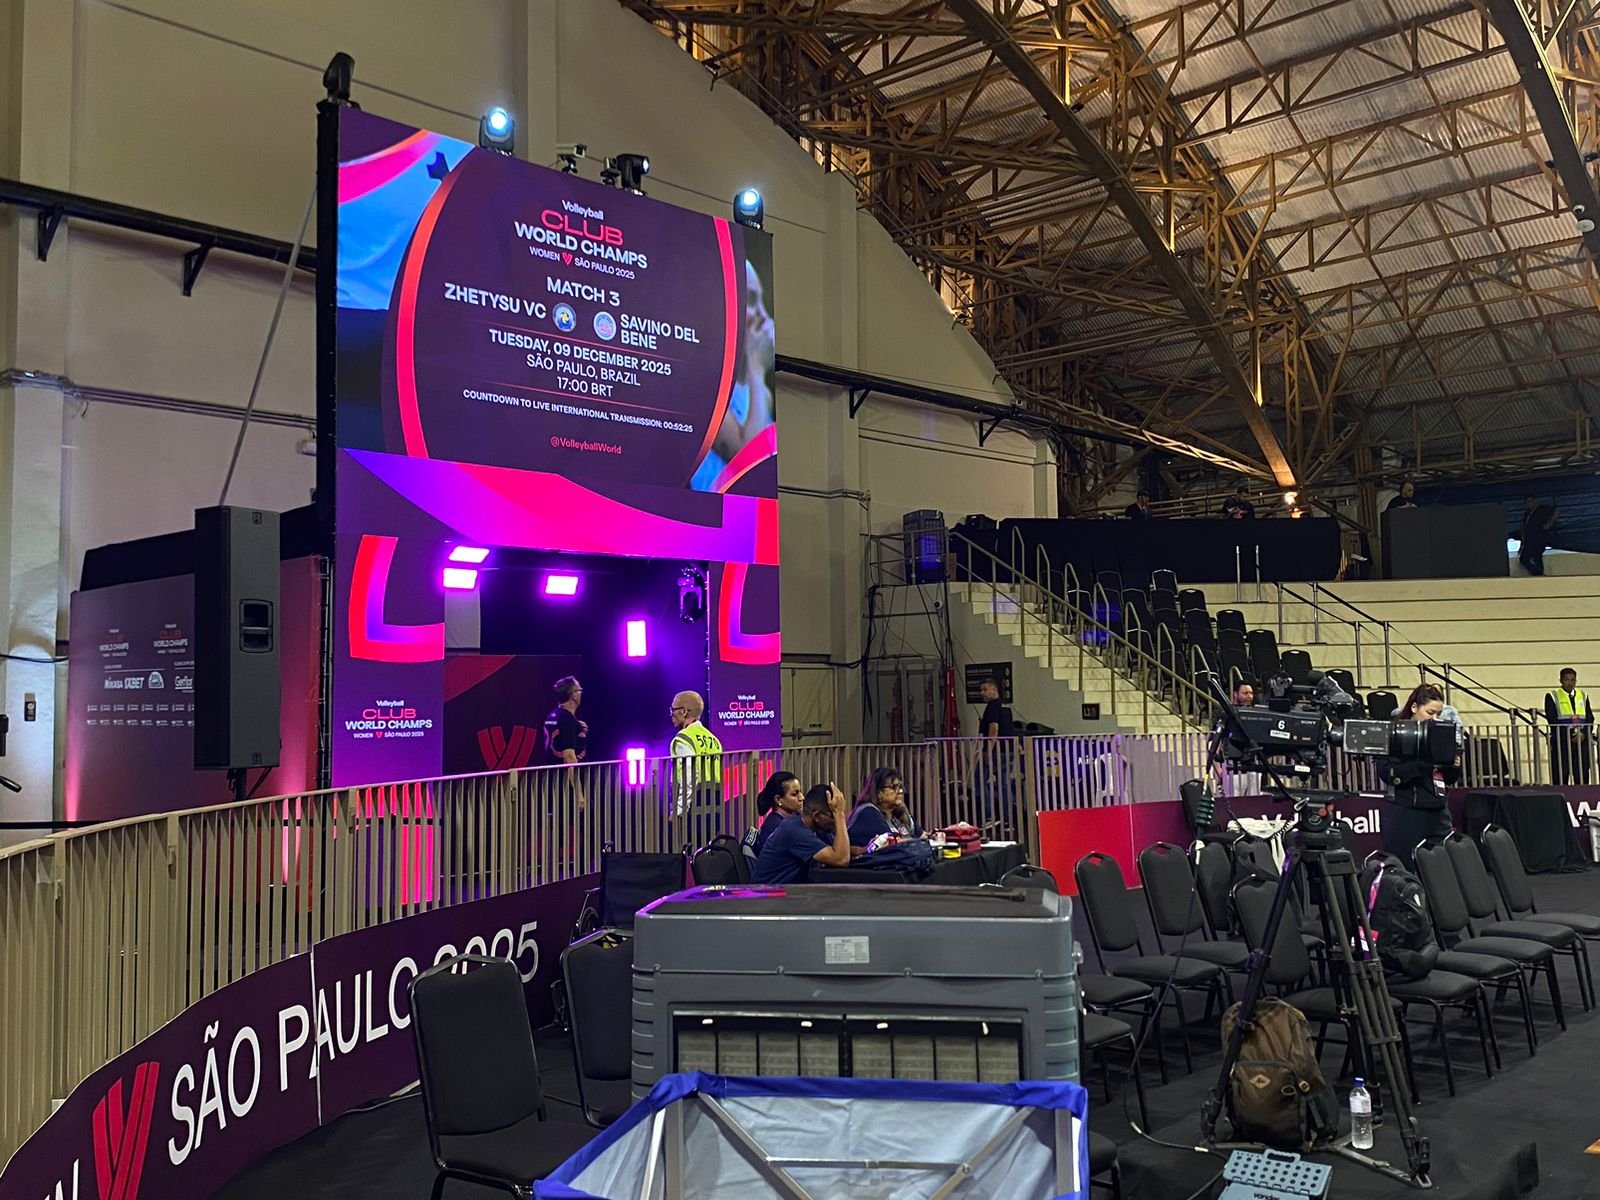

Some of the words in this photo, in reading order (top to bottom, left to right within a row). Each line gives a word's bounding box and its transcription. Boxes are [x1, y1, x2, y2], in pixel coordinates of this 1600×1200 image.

[562, 199, 604, 221] Volleyball
[541, 209, 623, 246] CLUB
[514, 221, 577, 251] WORLD
[581, 239, 648, 269] CHAMPS
[529, 246, 560, 262] WOMEN
[574, 256, 591, 269] SÃO
[591, 260, 615, 275] PAULO
[615, 266, 635, 280] 2025
[444, 282, 520, 314] ZHETYSU
[523, 299, 547, 319] VC
[547, 277, 605, 304] MATCH
[608, 291, 620, 306] 3
[620, 314, 671, 337] SAVINO
[674, 326, 699, 343] DEL
[621, 329, 657, 350] BENE
[488, 329, 551, 355] TUESDAY,
[553, 343, 570, 356] 09
[574, 346, 638, 369] DECEMBER
[641, 360, 672, 376] 2025
[526, 353, 553, 370] SÃO
[556, 360, 598, 380] PAULO,
[600, 368, 641, 386] BRAZIL
[556, 376, 588, 393] 17:00
[591, 384, 613, 397] BRT
[463, 389, 519, 406] COUNTDOWN
[520, 398, 532, 408] TO
[532, 400, 550, 411] LIVE
[551, 403, 609, 420] INTERNATIONAL
[610, 412, 662, 428] TRANSMISSION:
[663, 421, 693, 433] 00:52:25
[550, 436, 622, 454] @VolleyballWorld
[363, 708, 416, 719] CLUB
[718, 711, 744, 719] WORLD
[745, 710, 774, 719] CHAMPS
[729, 701, 764, 711] CLUB
[345, 720, 386, 730] WORLD
[388, 719, 432, 729] CHAMPS
[1278, 720, 1286, 730] 6
[167, 1020, 261, 1166] SÃO
[278, 957, 417, 1092] PAULO
